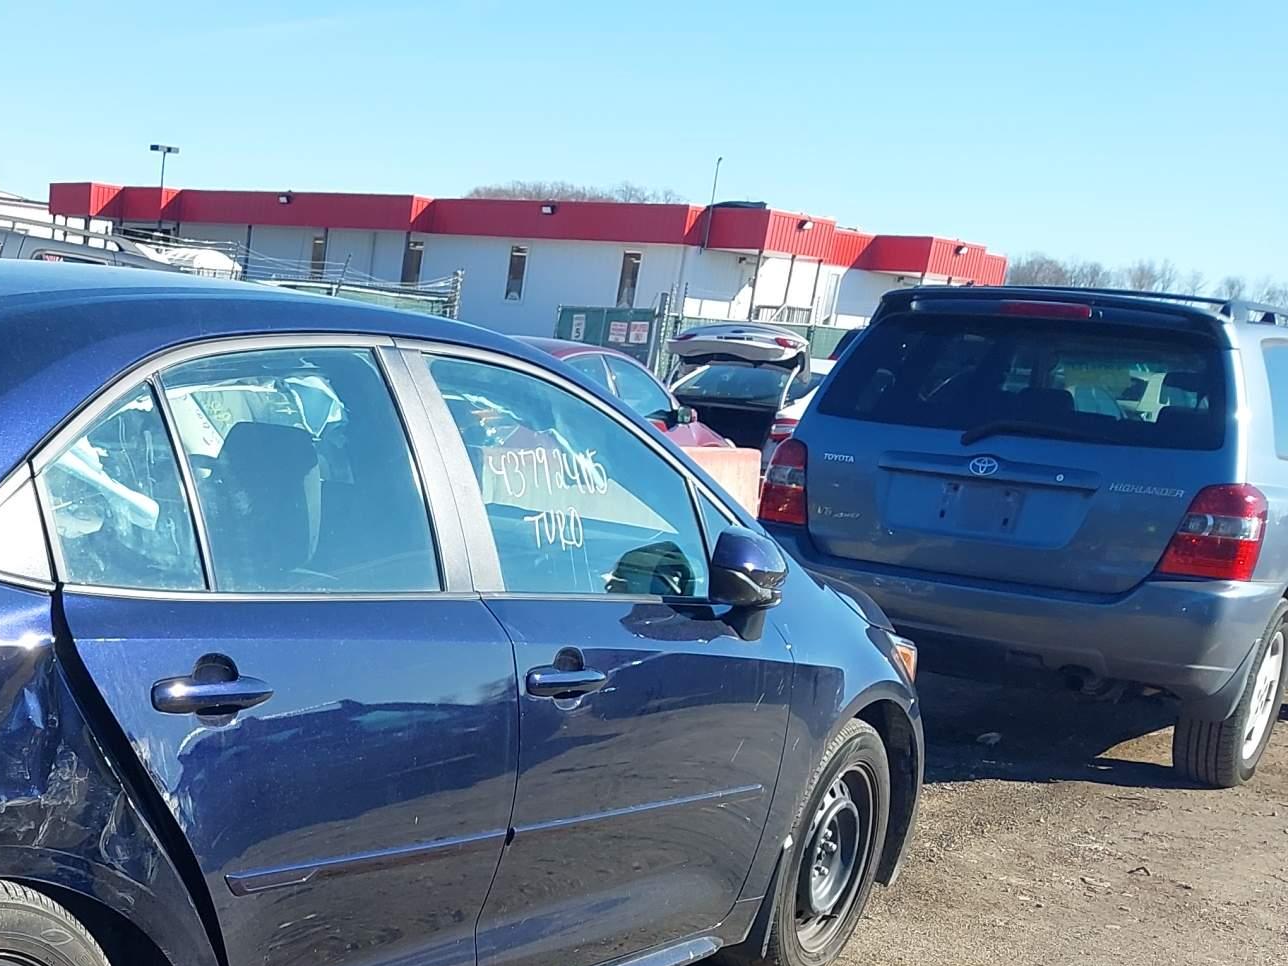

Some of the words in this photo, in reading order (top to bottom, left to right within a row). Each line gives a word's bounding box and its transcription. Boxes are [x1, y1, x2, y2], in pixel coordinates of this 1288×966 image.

[824, 452, 855, 463] TOYOTA
[1109, 482, 1185, 498] HIGHLANDER
[523, 506, 584, 551] TURO
